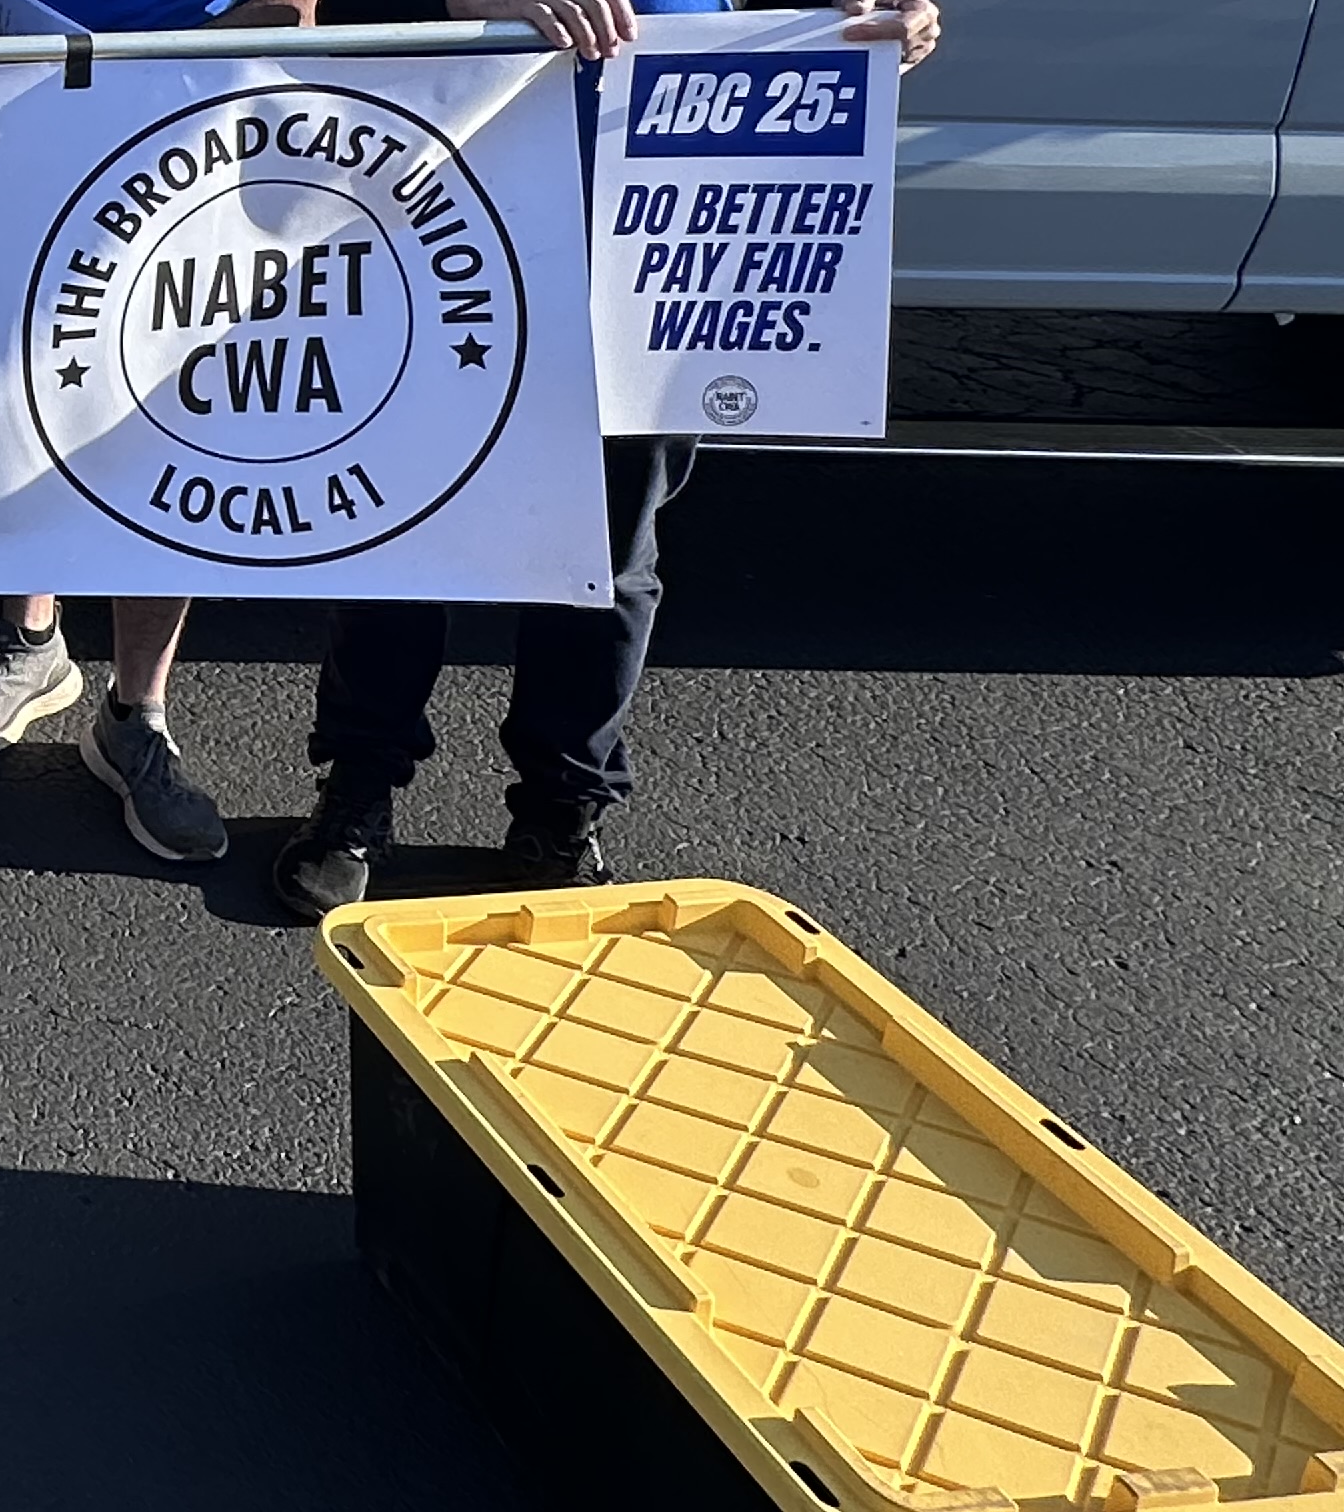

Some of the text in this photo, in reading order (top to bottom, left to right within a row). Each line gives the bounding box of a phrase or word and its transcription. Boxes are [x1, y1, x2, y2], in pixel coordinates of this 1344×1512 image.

[635, 70, 856, 136] ABC 25:
[53, 112, 493, 350] THE BROADCAST UNION
[613, 182, 874, 237] DO BETTER!
[151, 241, 373, 331] NABET
[634, 242, 844, 294] PAY FAIR
[648, 300, 822, 352] WAGES.
[178, 336, 343, 415] CWA
[149, 462, 386, 535] LOCAL 41
